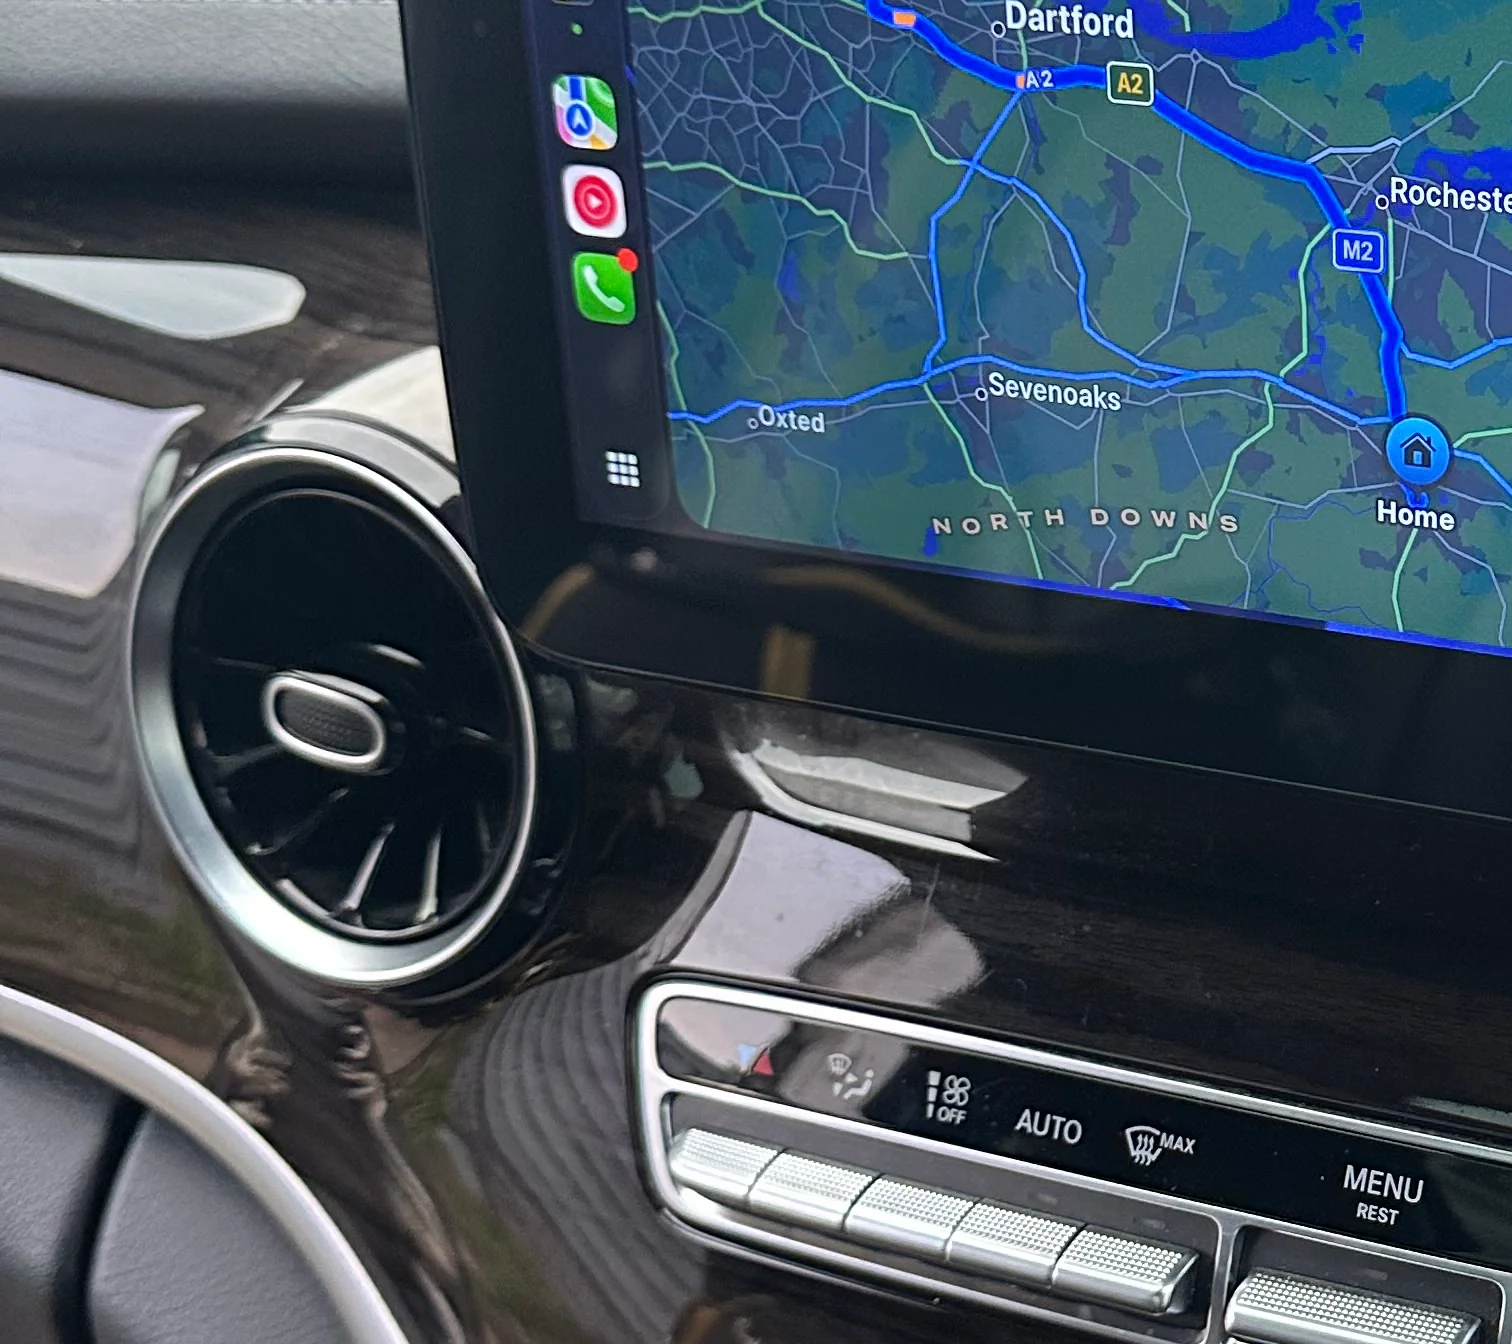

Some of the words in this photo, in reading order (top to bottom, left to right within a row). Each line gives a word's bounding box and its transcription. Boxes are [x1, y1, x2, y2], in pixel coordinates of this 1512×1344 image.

[1005, 0, 1134, 39] Dartford
[1117, 72, 1144, 94] A2
[1342, 239, 1374, 262] M2
[988, 372, 1121, 412] Sevenoaks
[758, 404, 826, 433] Oxted
[931, 508, 1065, 536] NORTH
[1090, 507, 1239, 533] DOWNS
[1376, 499, 1456, 532] Home
[936, 1105, 968, 1126] OFF
[1014, 1108, 1083, 1145] AUTO
[1159, 1132, 1197, 1155] MAX
[1343, 1163, 1424, 1204] MENU
[1356, 1201, 1400, 1227] REST
